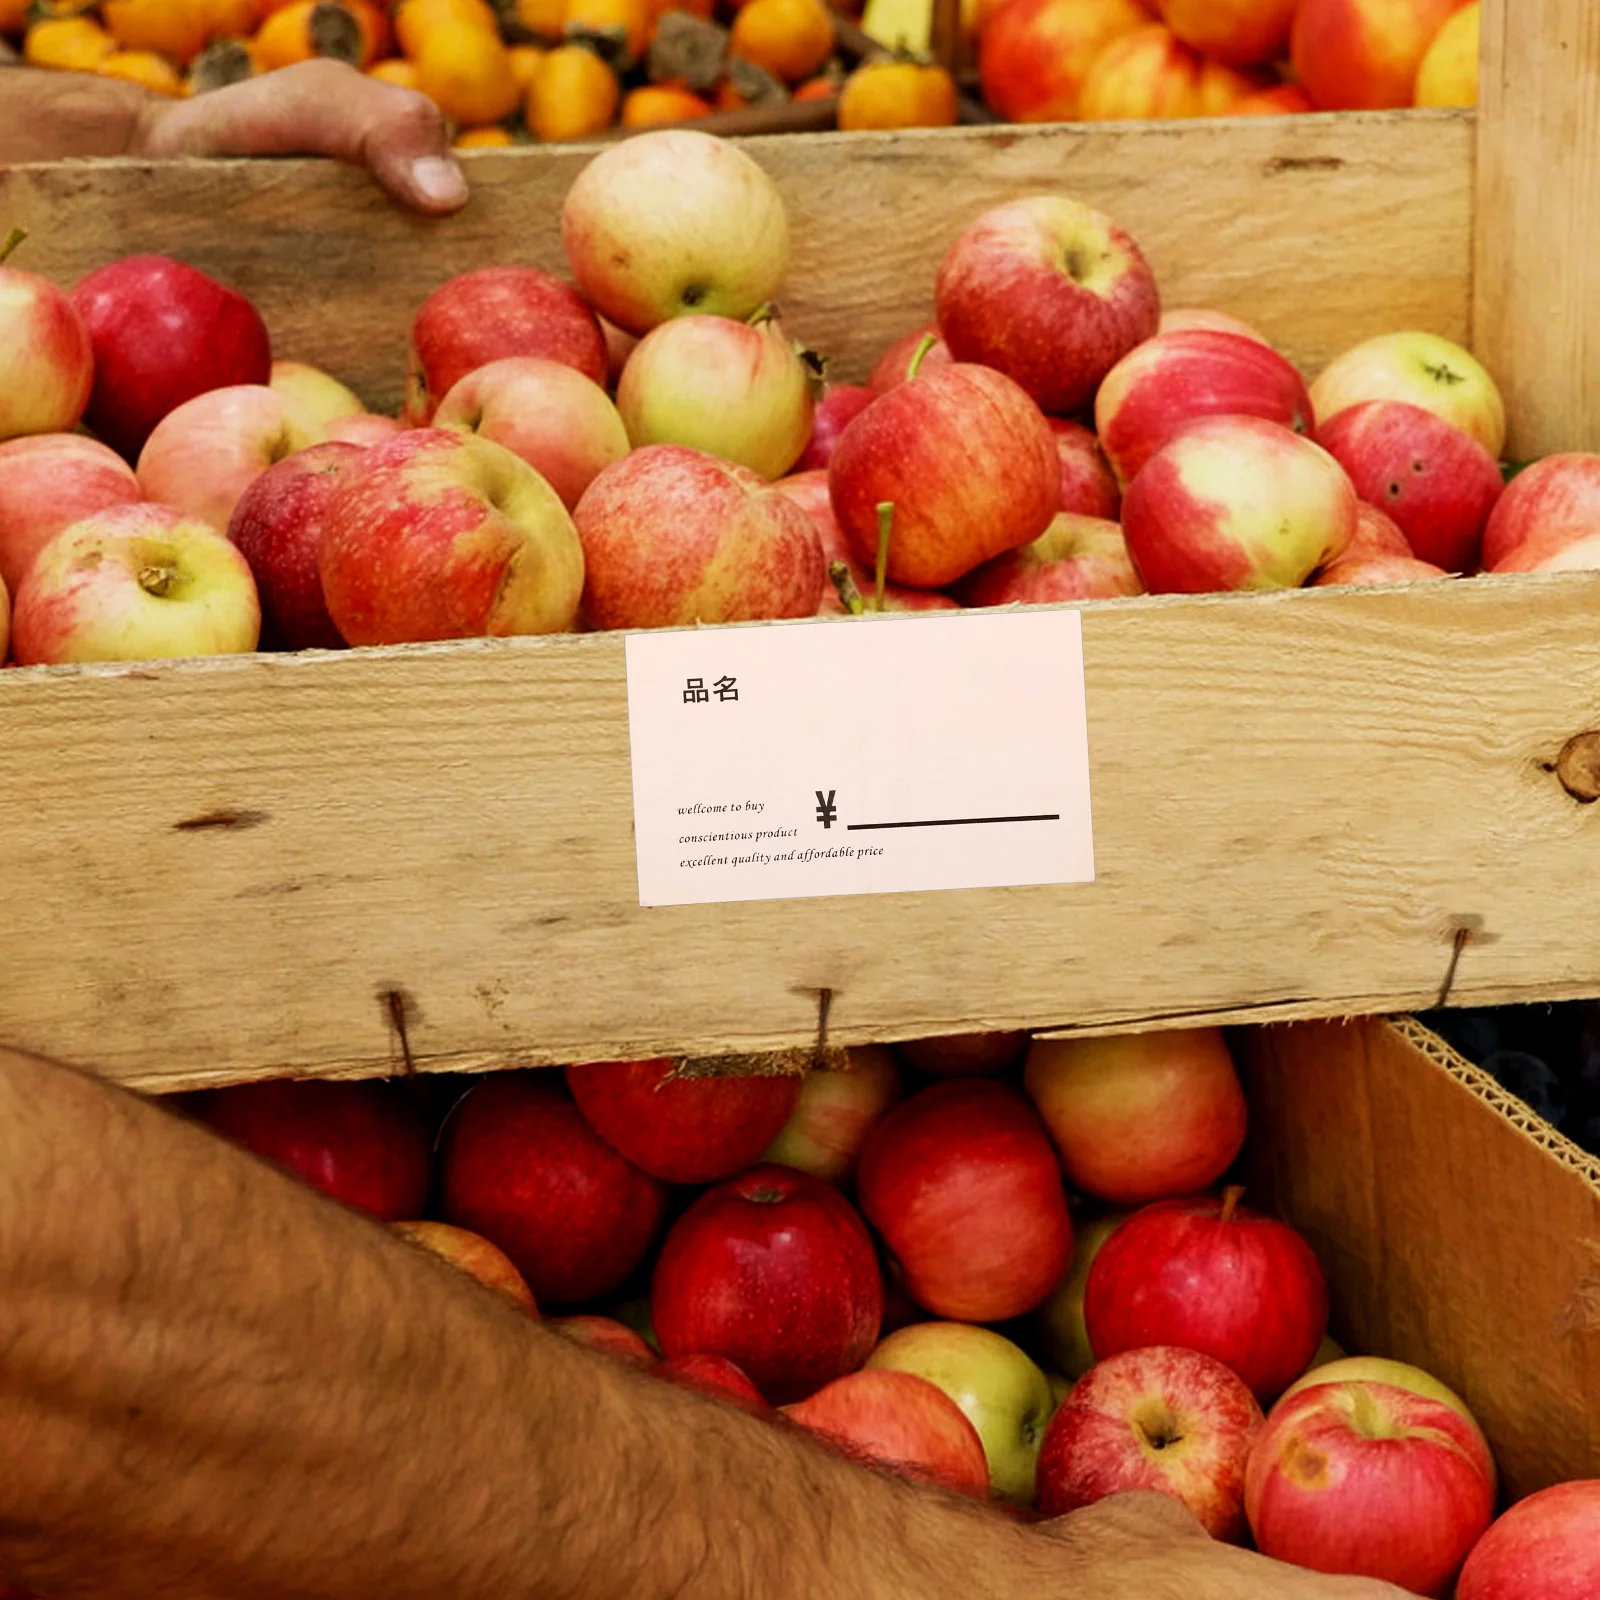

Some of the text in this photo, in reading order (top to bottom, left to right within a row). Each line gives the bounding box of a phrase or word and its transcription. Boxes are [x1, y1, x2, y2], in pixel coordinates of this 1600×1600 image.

[682, 675, 739, 704] 品名
[677, 800, 765, 815] wellcome to buy
[815, 790, 838, 829] ¥
[679, 827, 798, 844] conscientious product
[680, 846, 884, 868] excellent quality and affordable price
